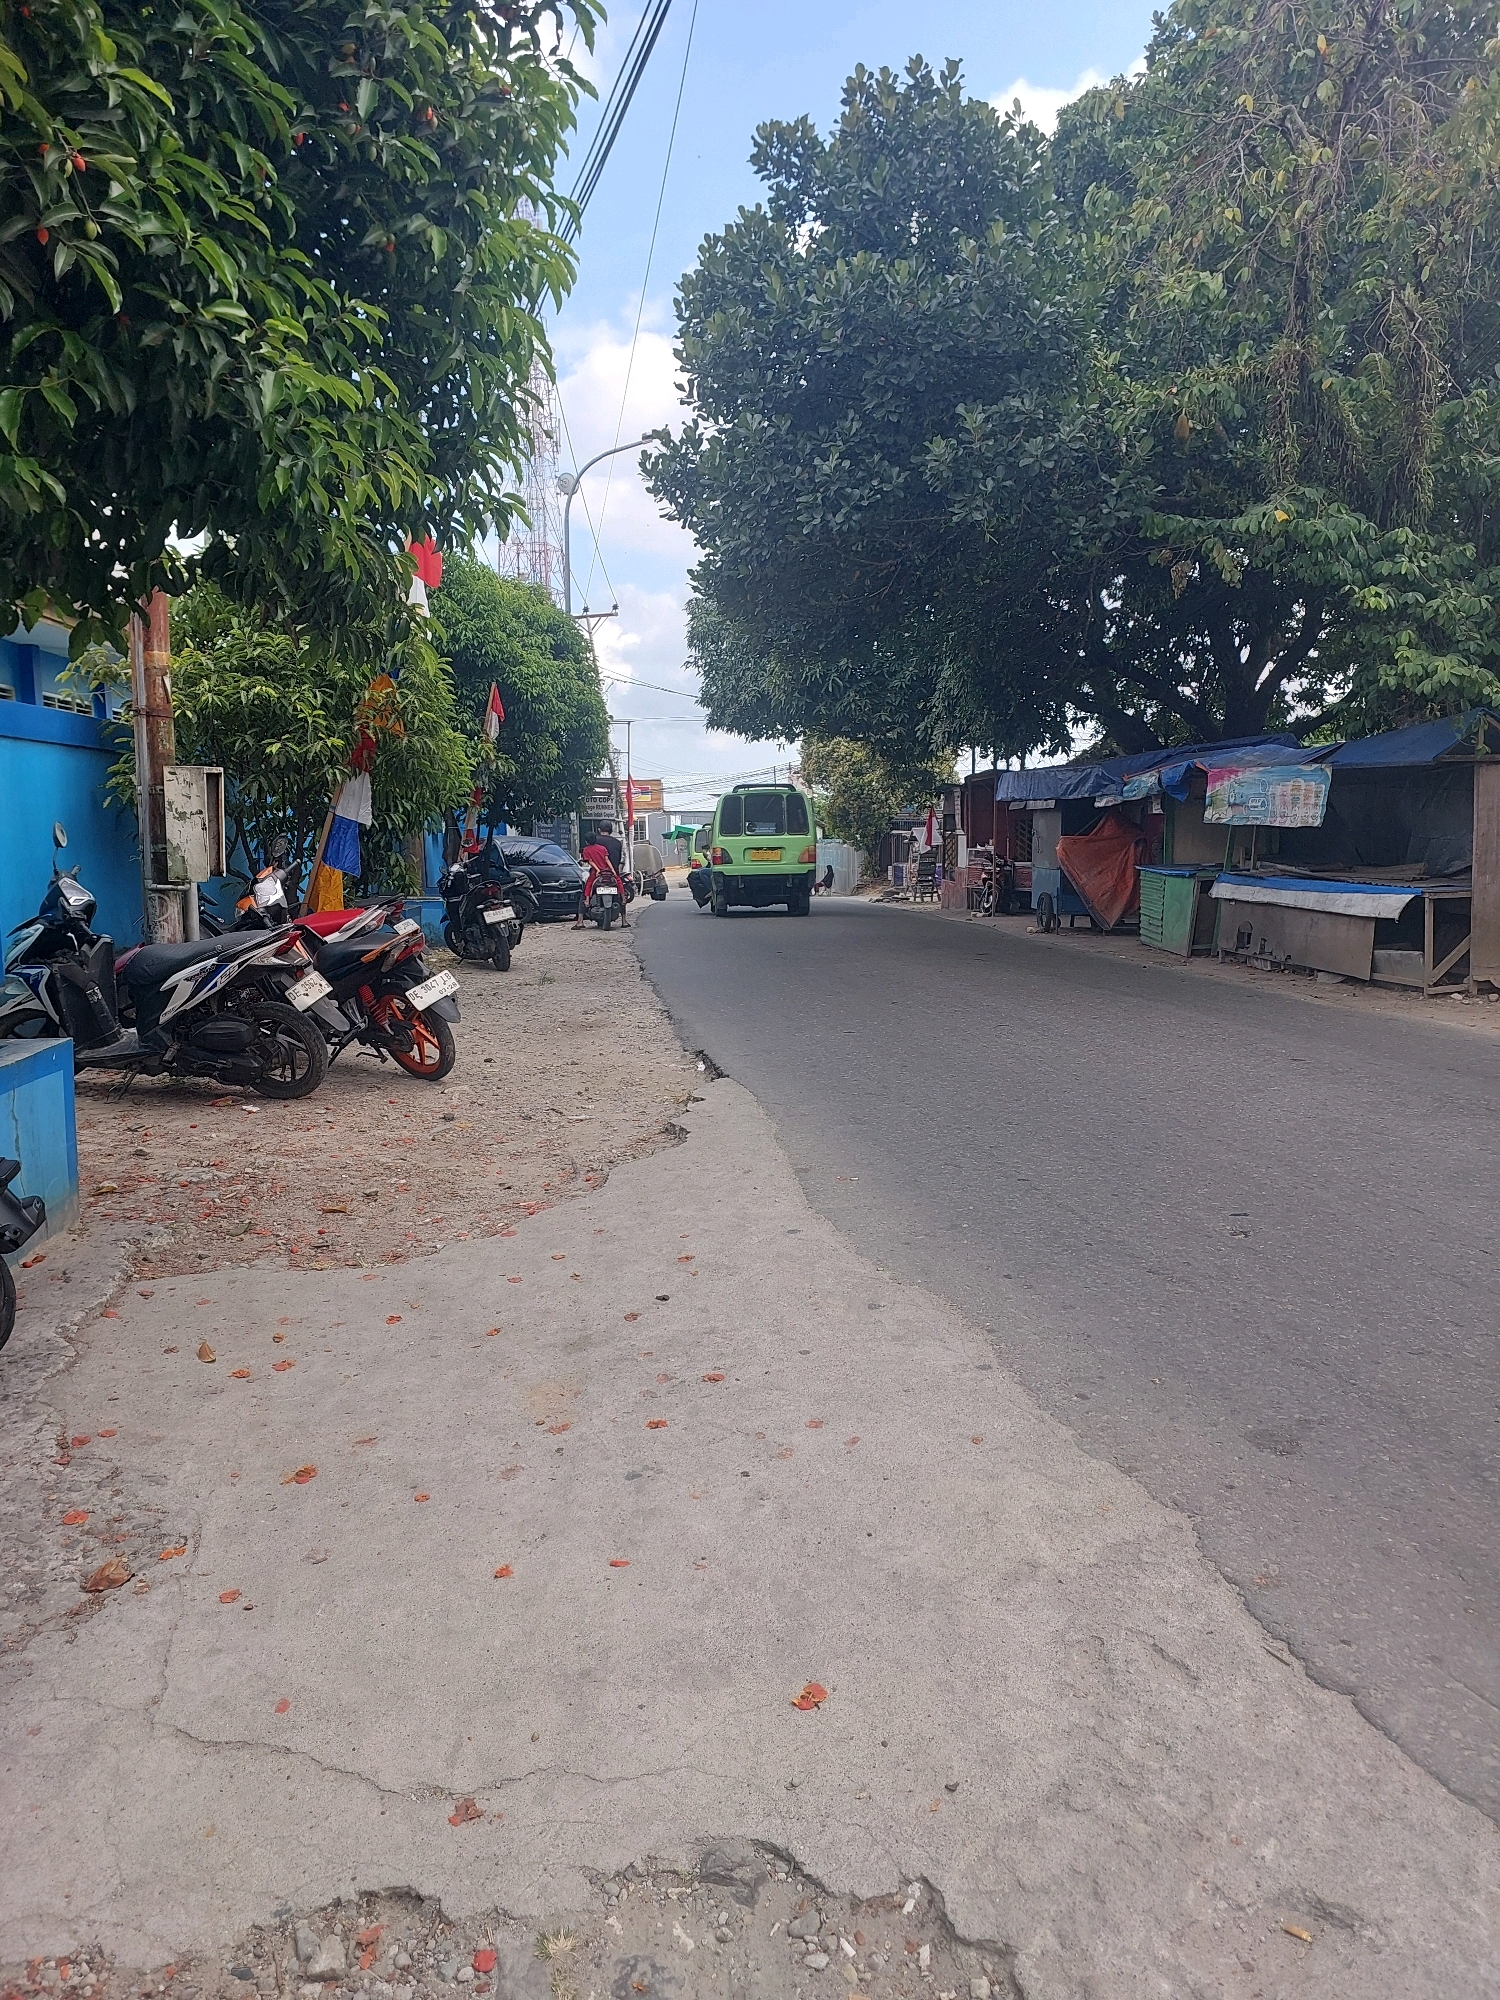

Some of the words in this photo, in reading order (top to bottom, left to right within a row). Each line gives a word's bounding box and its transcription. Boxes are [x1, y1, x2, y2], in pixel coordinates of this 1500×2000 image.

[287, 987, 302, 1001] DE
[408, 989, 422, 1001] DE
[420, 978, 440, 994] 3047
